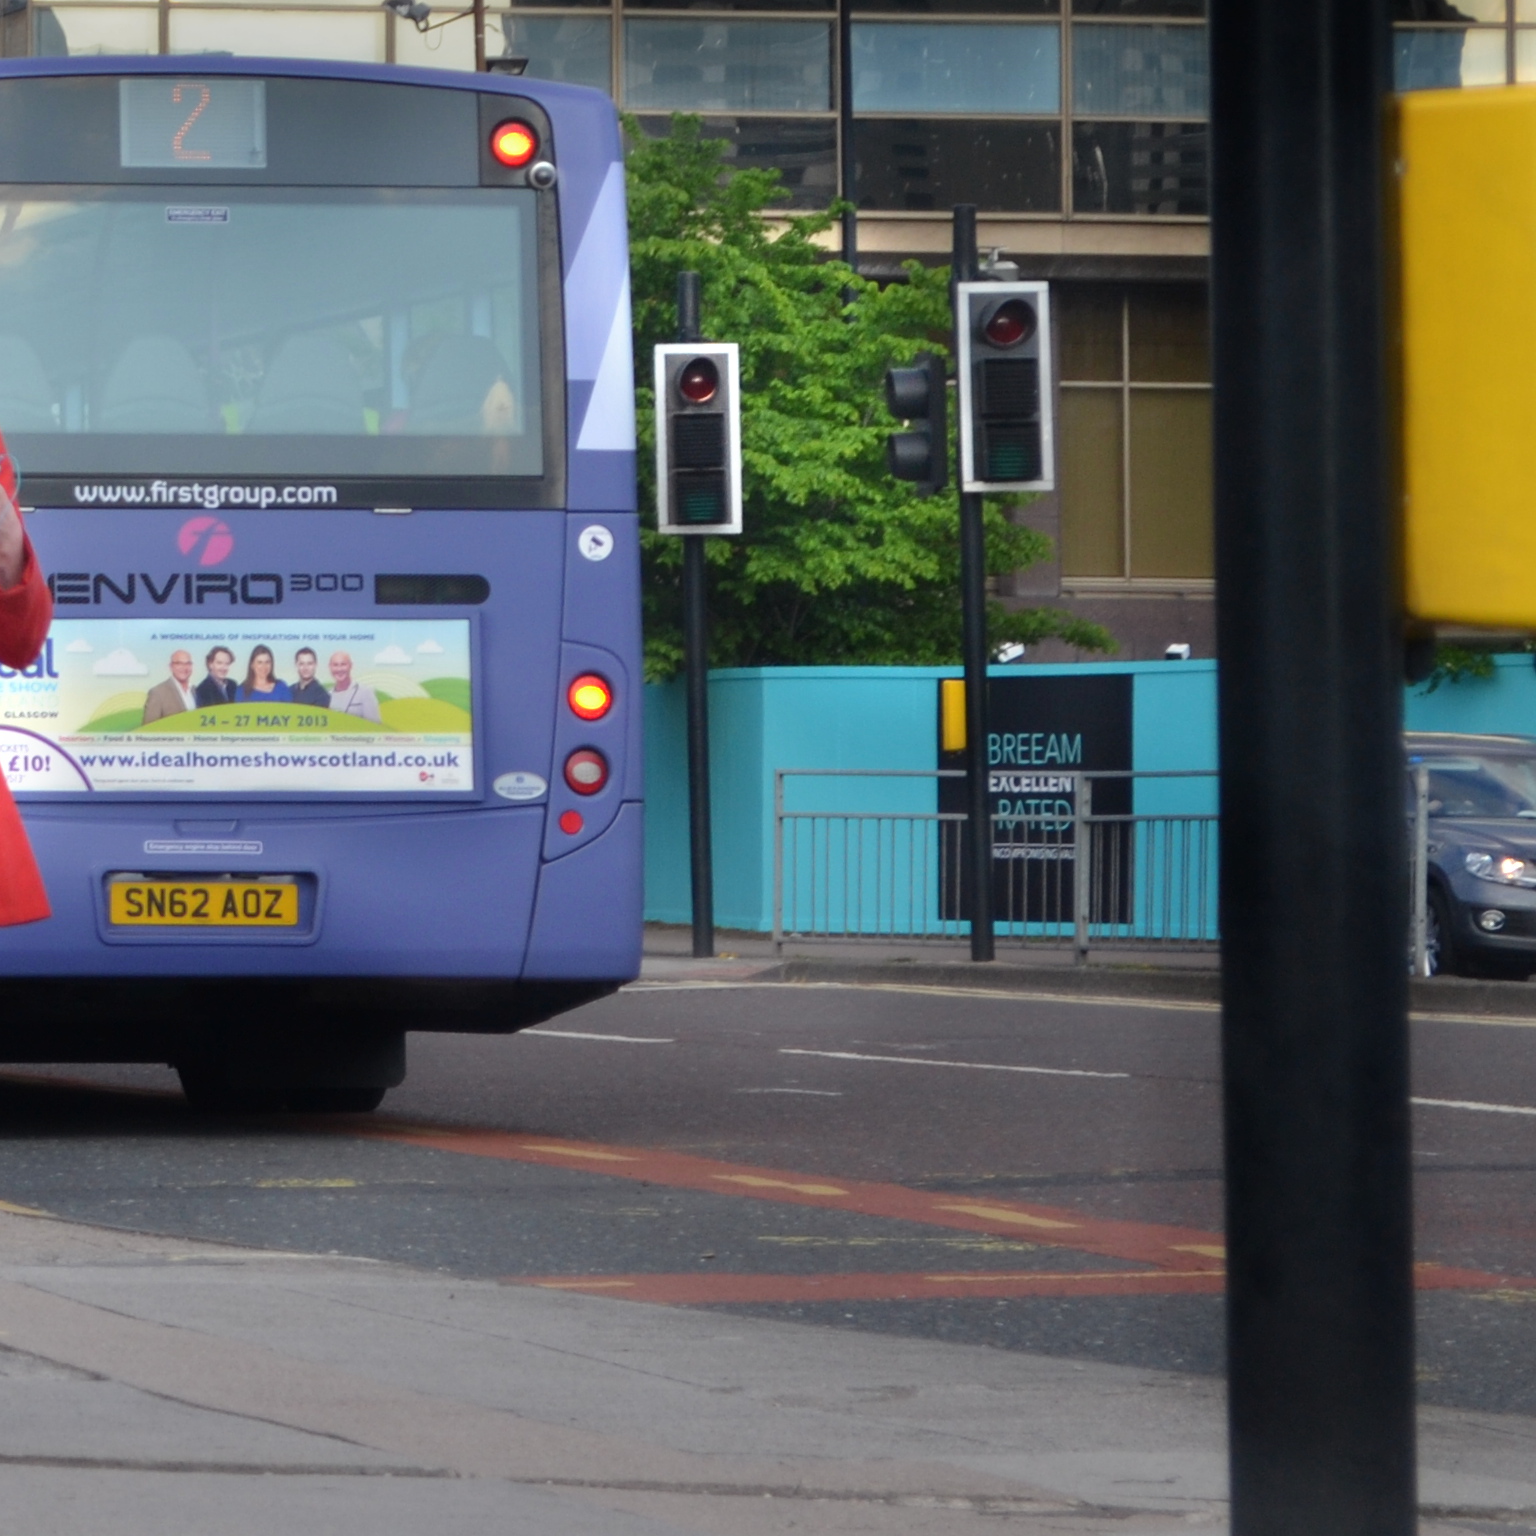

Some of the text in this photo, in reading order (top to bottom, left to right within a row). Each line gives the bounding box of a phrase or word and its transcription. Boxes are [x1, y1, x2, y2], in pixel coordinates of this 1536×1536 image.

[172, 83, 212, 161] 2
[73, 480, 338, 509] www.firstgroup.com
[4, 711, 60, 719] GLASGOW
[200, 715, 217, 727] 24
[234, 715, 250, 727] 27
[256, 714, 291, 726] MAY
[297, 714, 328, 726] 2013
[79, 751, 460, 768] www.idealhomeshowscotland.co.uk
[988, 733, 1082, 764] BREEAM
[8, 755, 52, 772] £10!
[988, 774, 1075, 793] EXCELLEN
[997, 799, 1073, 831] RATED
[125, 887, 284, 919] SN62 AOZ
